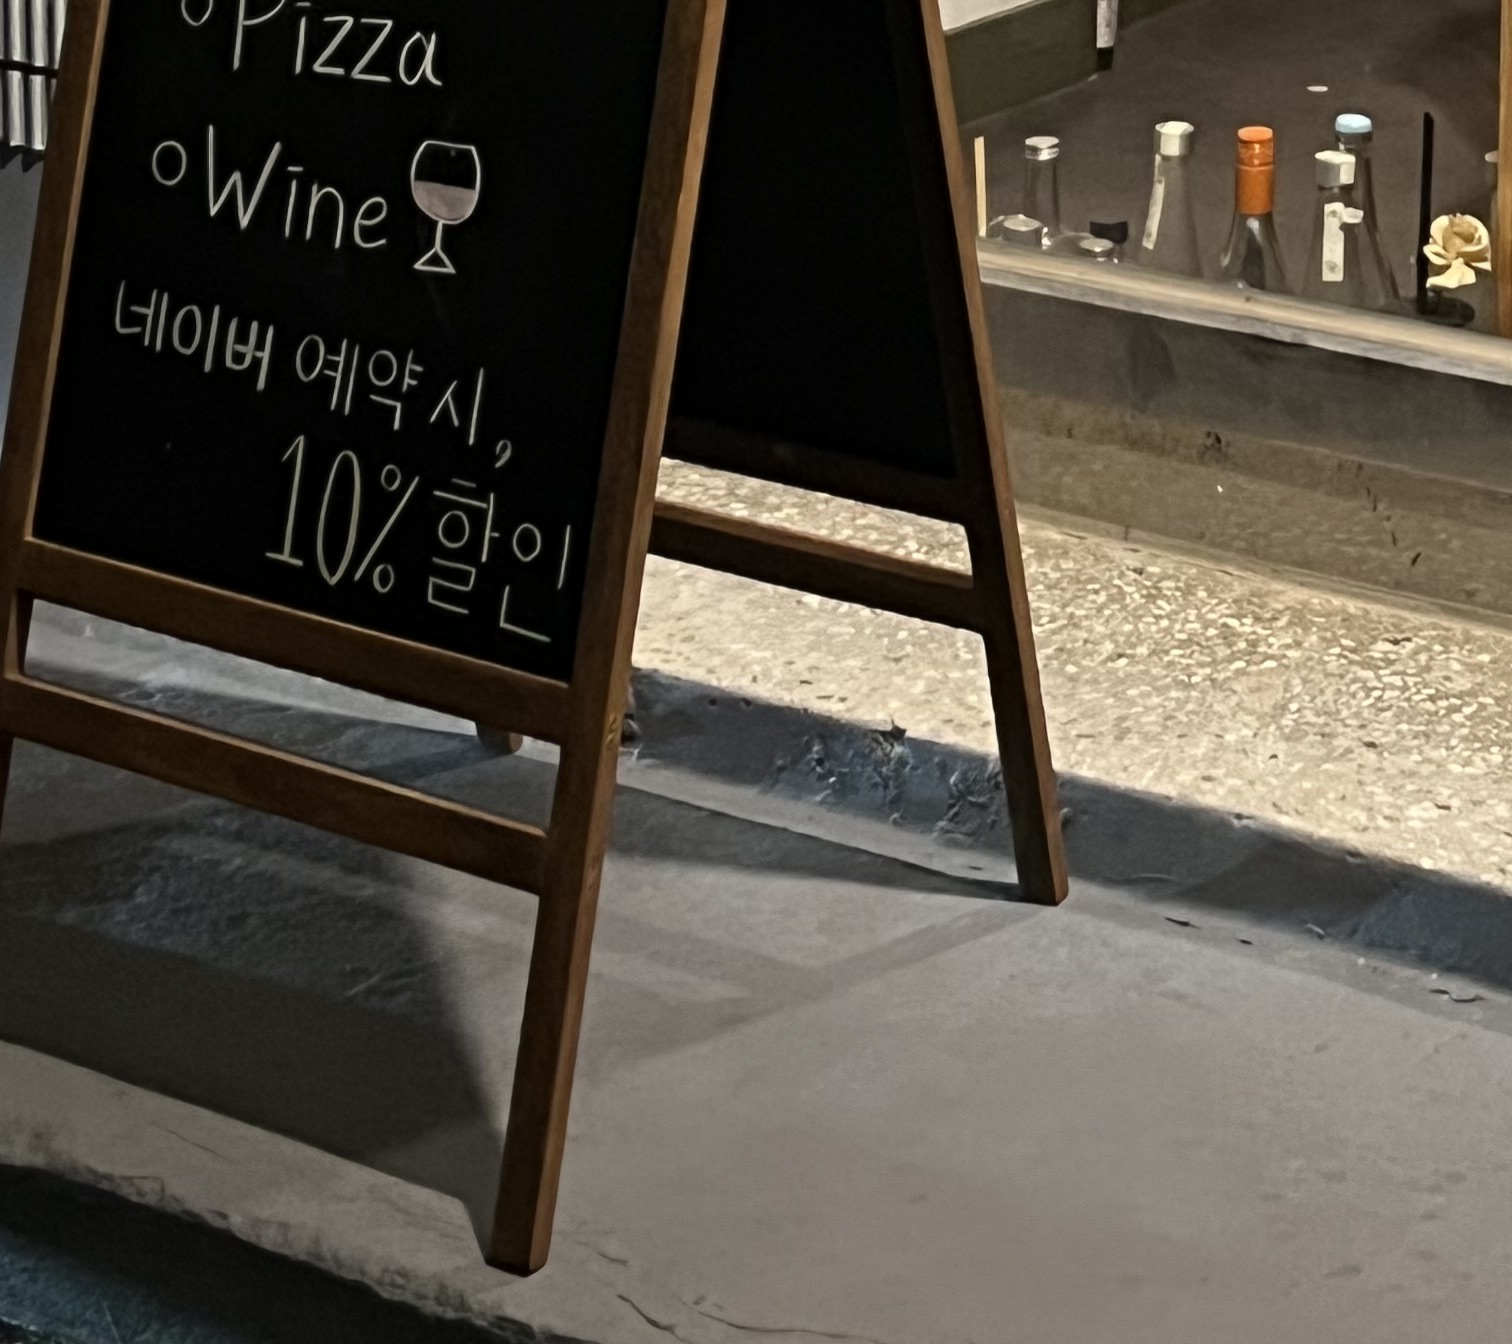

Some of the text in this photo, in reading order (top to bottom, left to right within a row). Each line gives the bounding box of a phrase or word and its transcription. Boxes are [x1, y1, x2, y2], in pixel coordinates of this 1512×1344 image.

[208, 124, 388, 250] Wine
[114, 280, 275, 391] 네이버
[296, 335, 424, 432] 예약
[266, 434, 572, 643] 10% 할인
